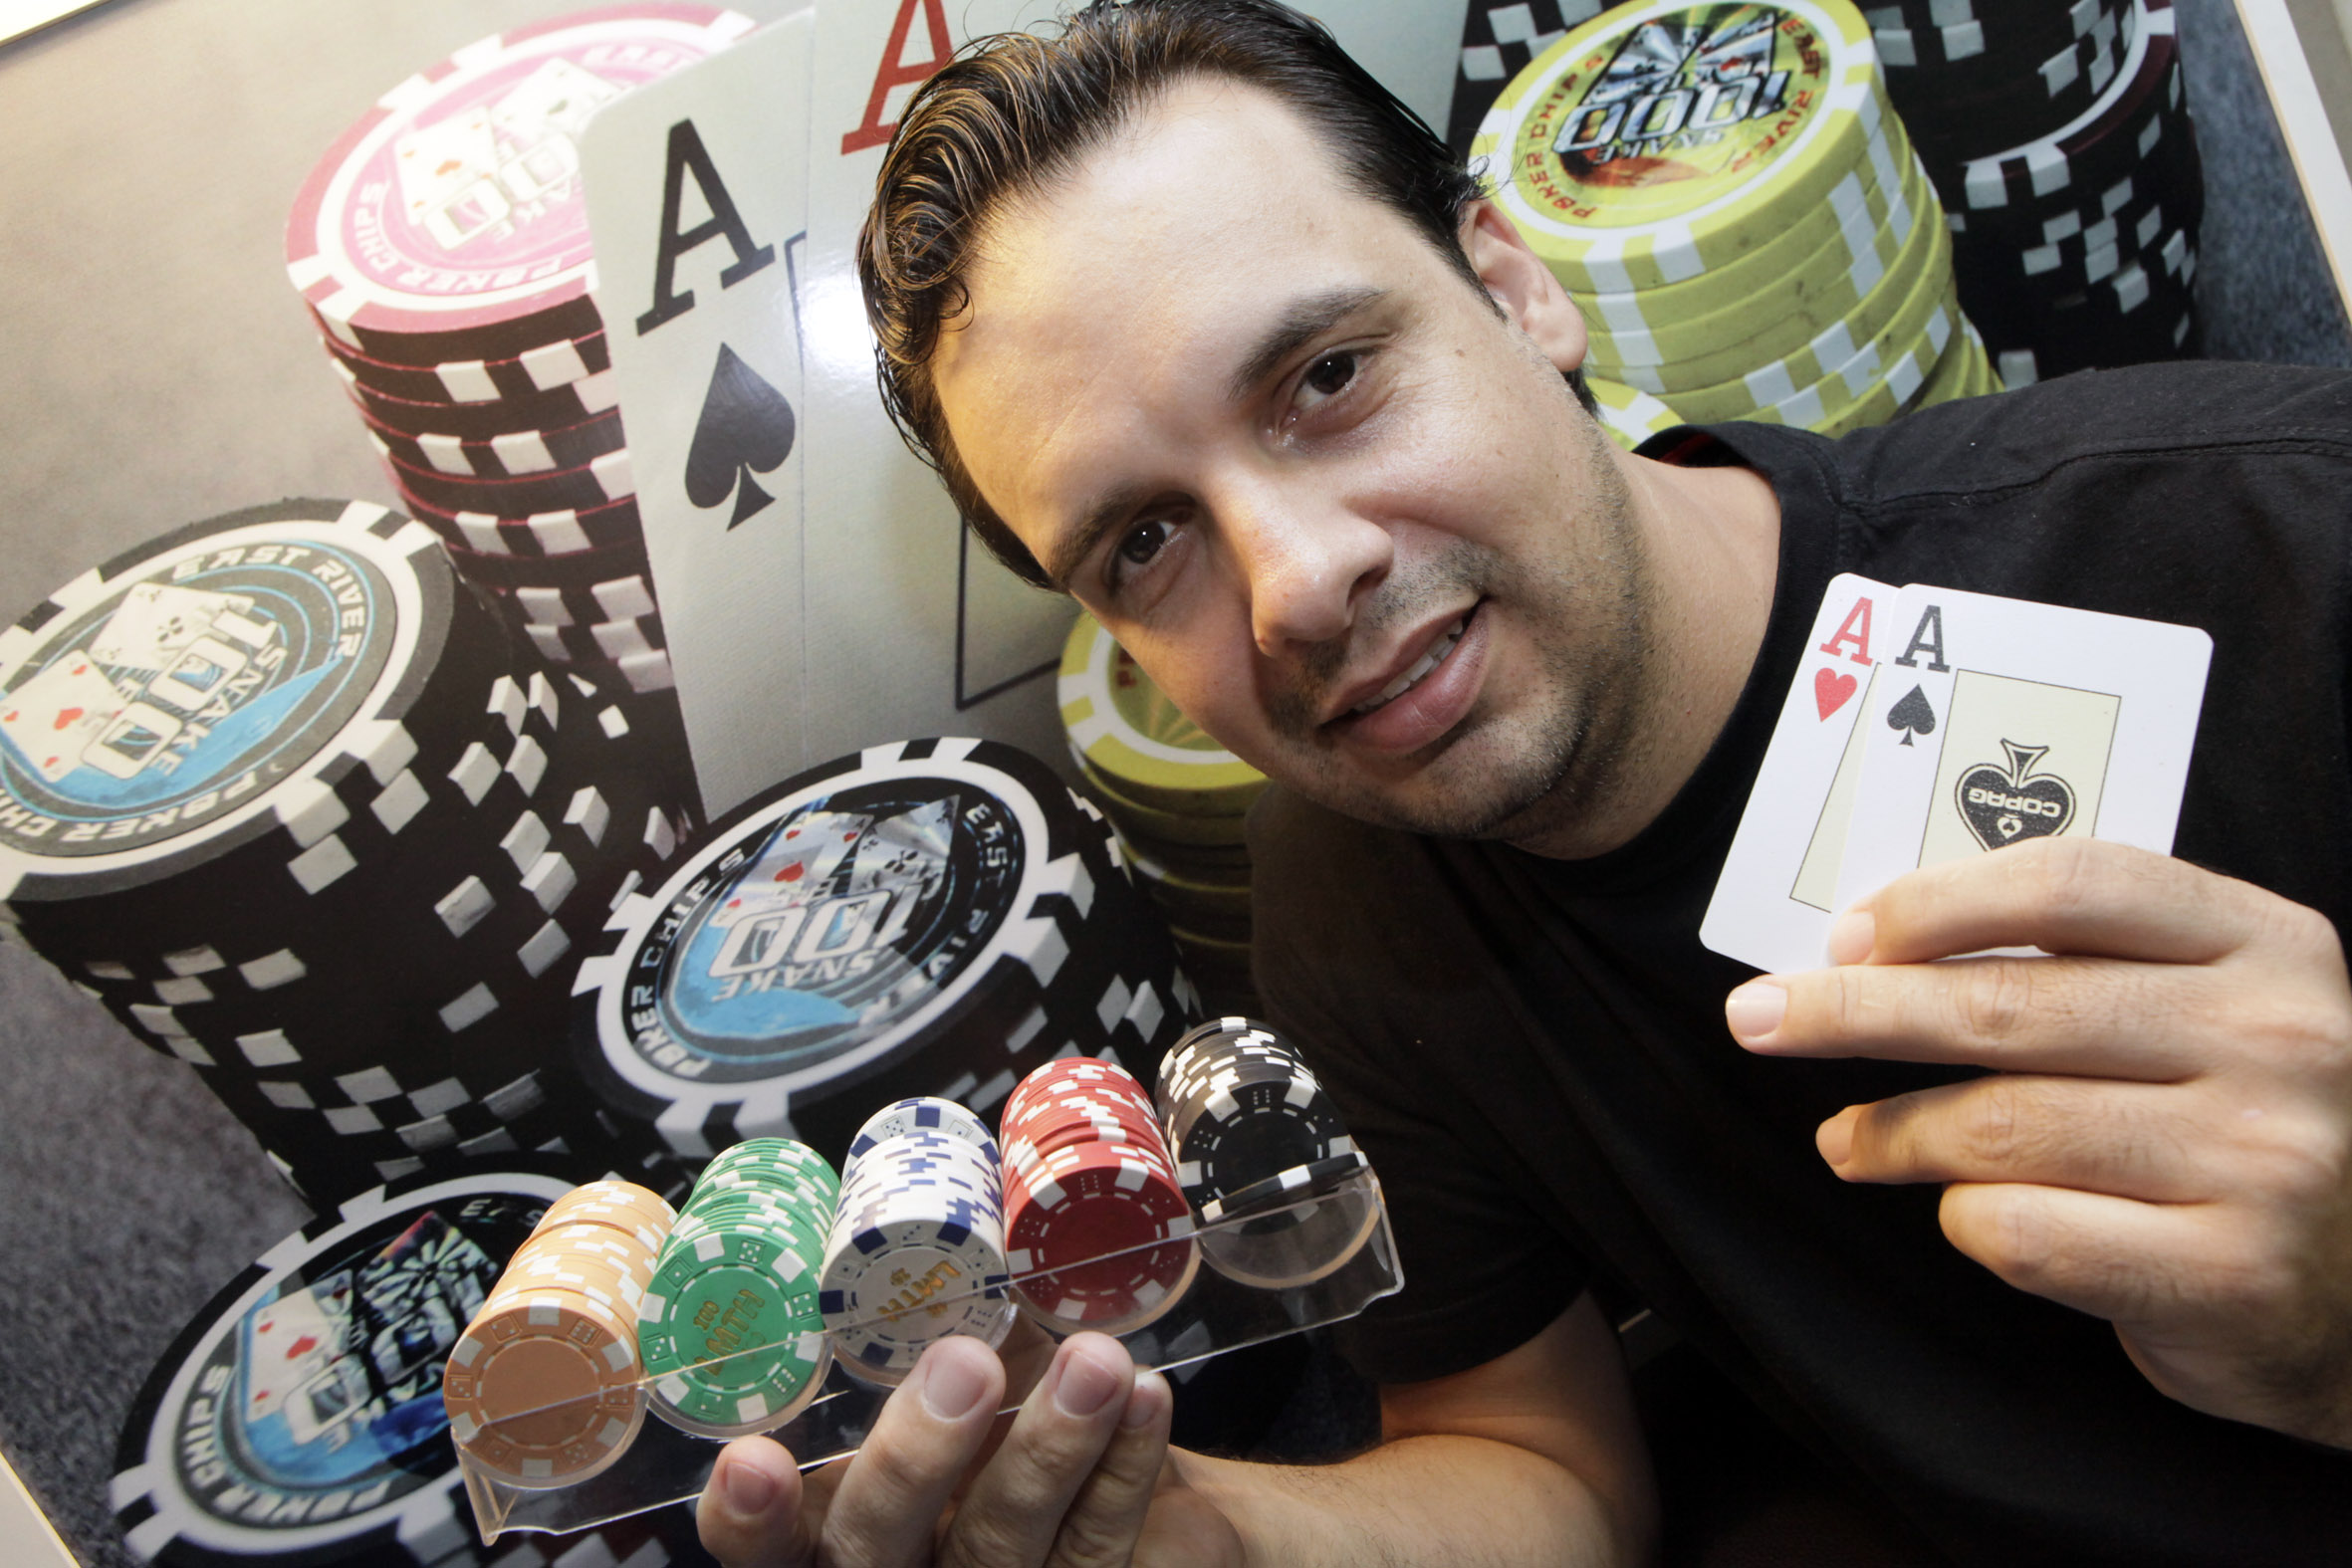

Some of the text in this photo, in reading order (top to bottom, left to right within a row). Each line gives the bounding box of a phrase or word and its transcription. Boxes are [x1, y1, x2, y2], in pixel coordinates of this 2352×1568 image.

[841, 0, 955, 156] A
[635, 117, 776, 336] A
[1526, 152, 1597, 218] POKER
[172, 546, 364, 656] EAST RIVER
[1819, 596, 1873, 667] A
[1894, 604, 1951, 673] A
[80, 610, 280, 780] 100
[150, 644, 288, 777] SNAKE
[60, 771, 257, 842] POKER
[1968, 787, 2061, 818] COPAG
[631, 847, 745, 1077] POKER CHIPS
[708, 883, 923, 979] 100
[711, 949, 877, 1003] SNAKE
